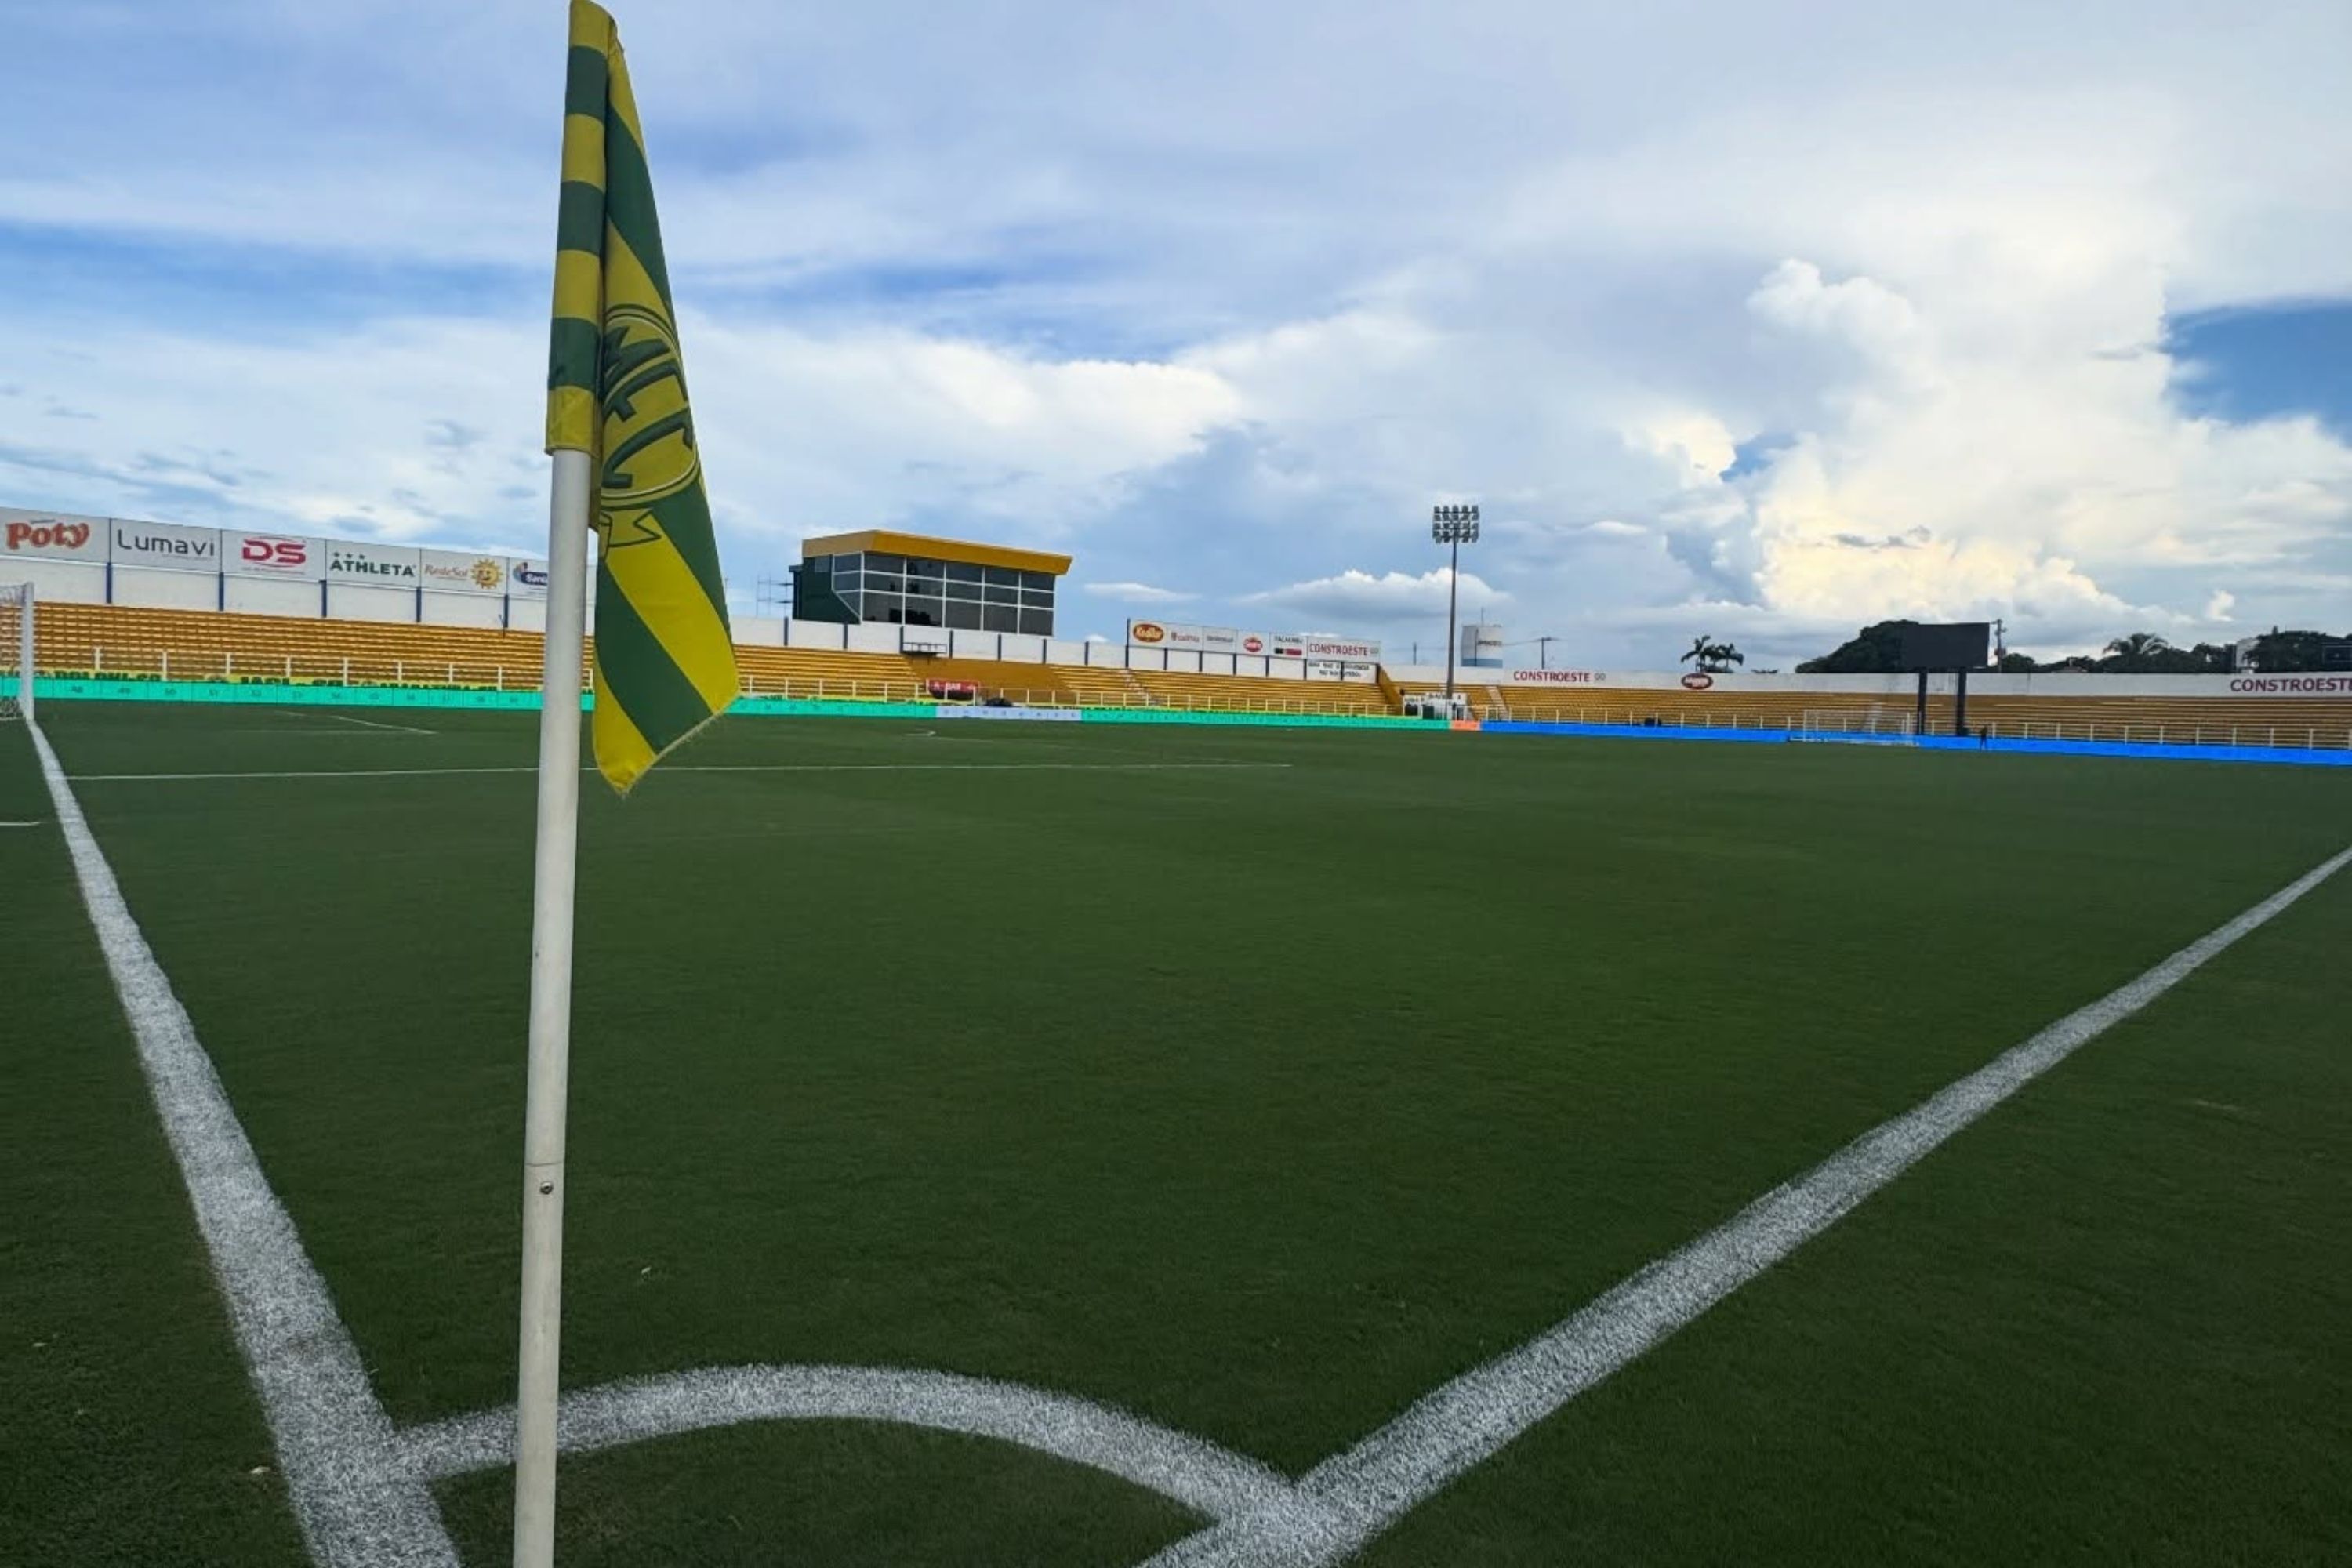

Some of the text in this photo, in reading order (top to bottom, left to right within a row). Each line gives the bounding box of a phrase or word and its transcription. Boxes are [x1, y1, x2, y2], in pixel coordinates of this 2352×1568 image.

[5, 522, 89, 550] Poty
[118, 528, 215, 556] Lumavi
[241, 539, 307, 564] DS
[330, 559, 415, 577] ATHLETA
[1309, 644, 1368, 656] CONSTROESTE
[1513, 670, 1591, 682] CONSTROESTE
